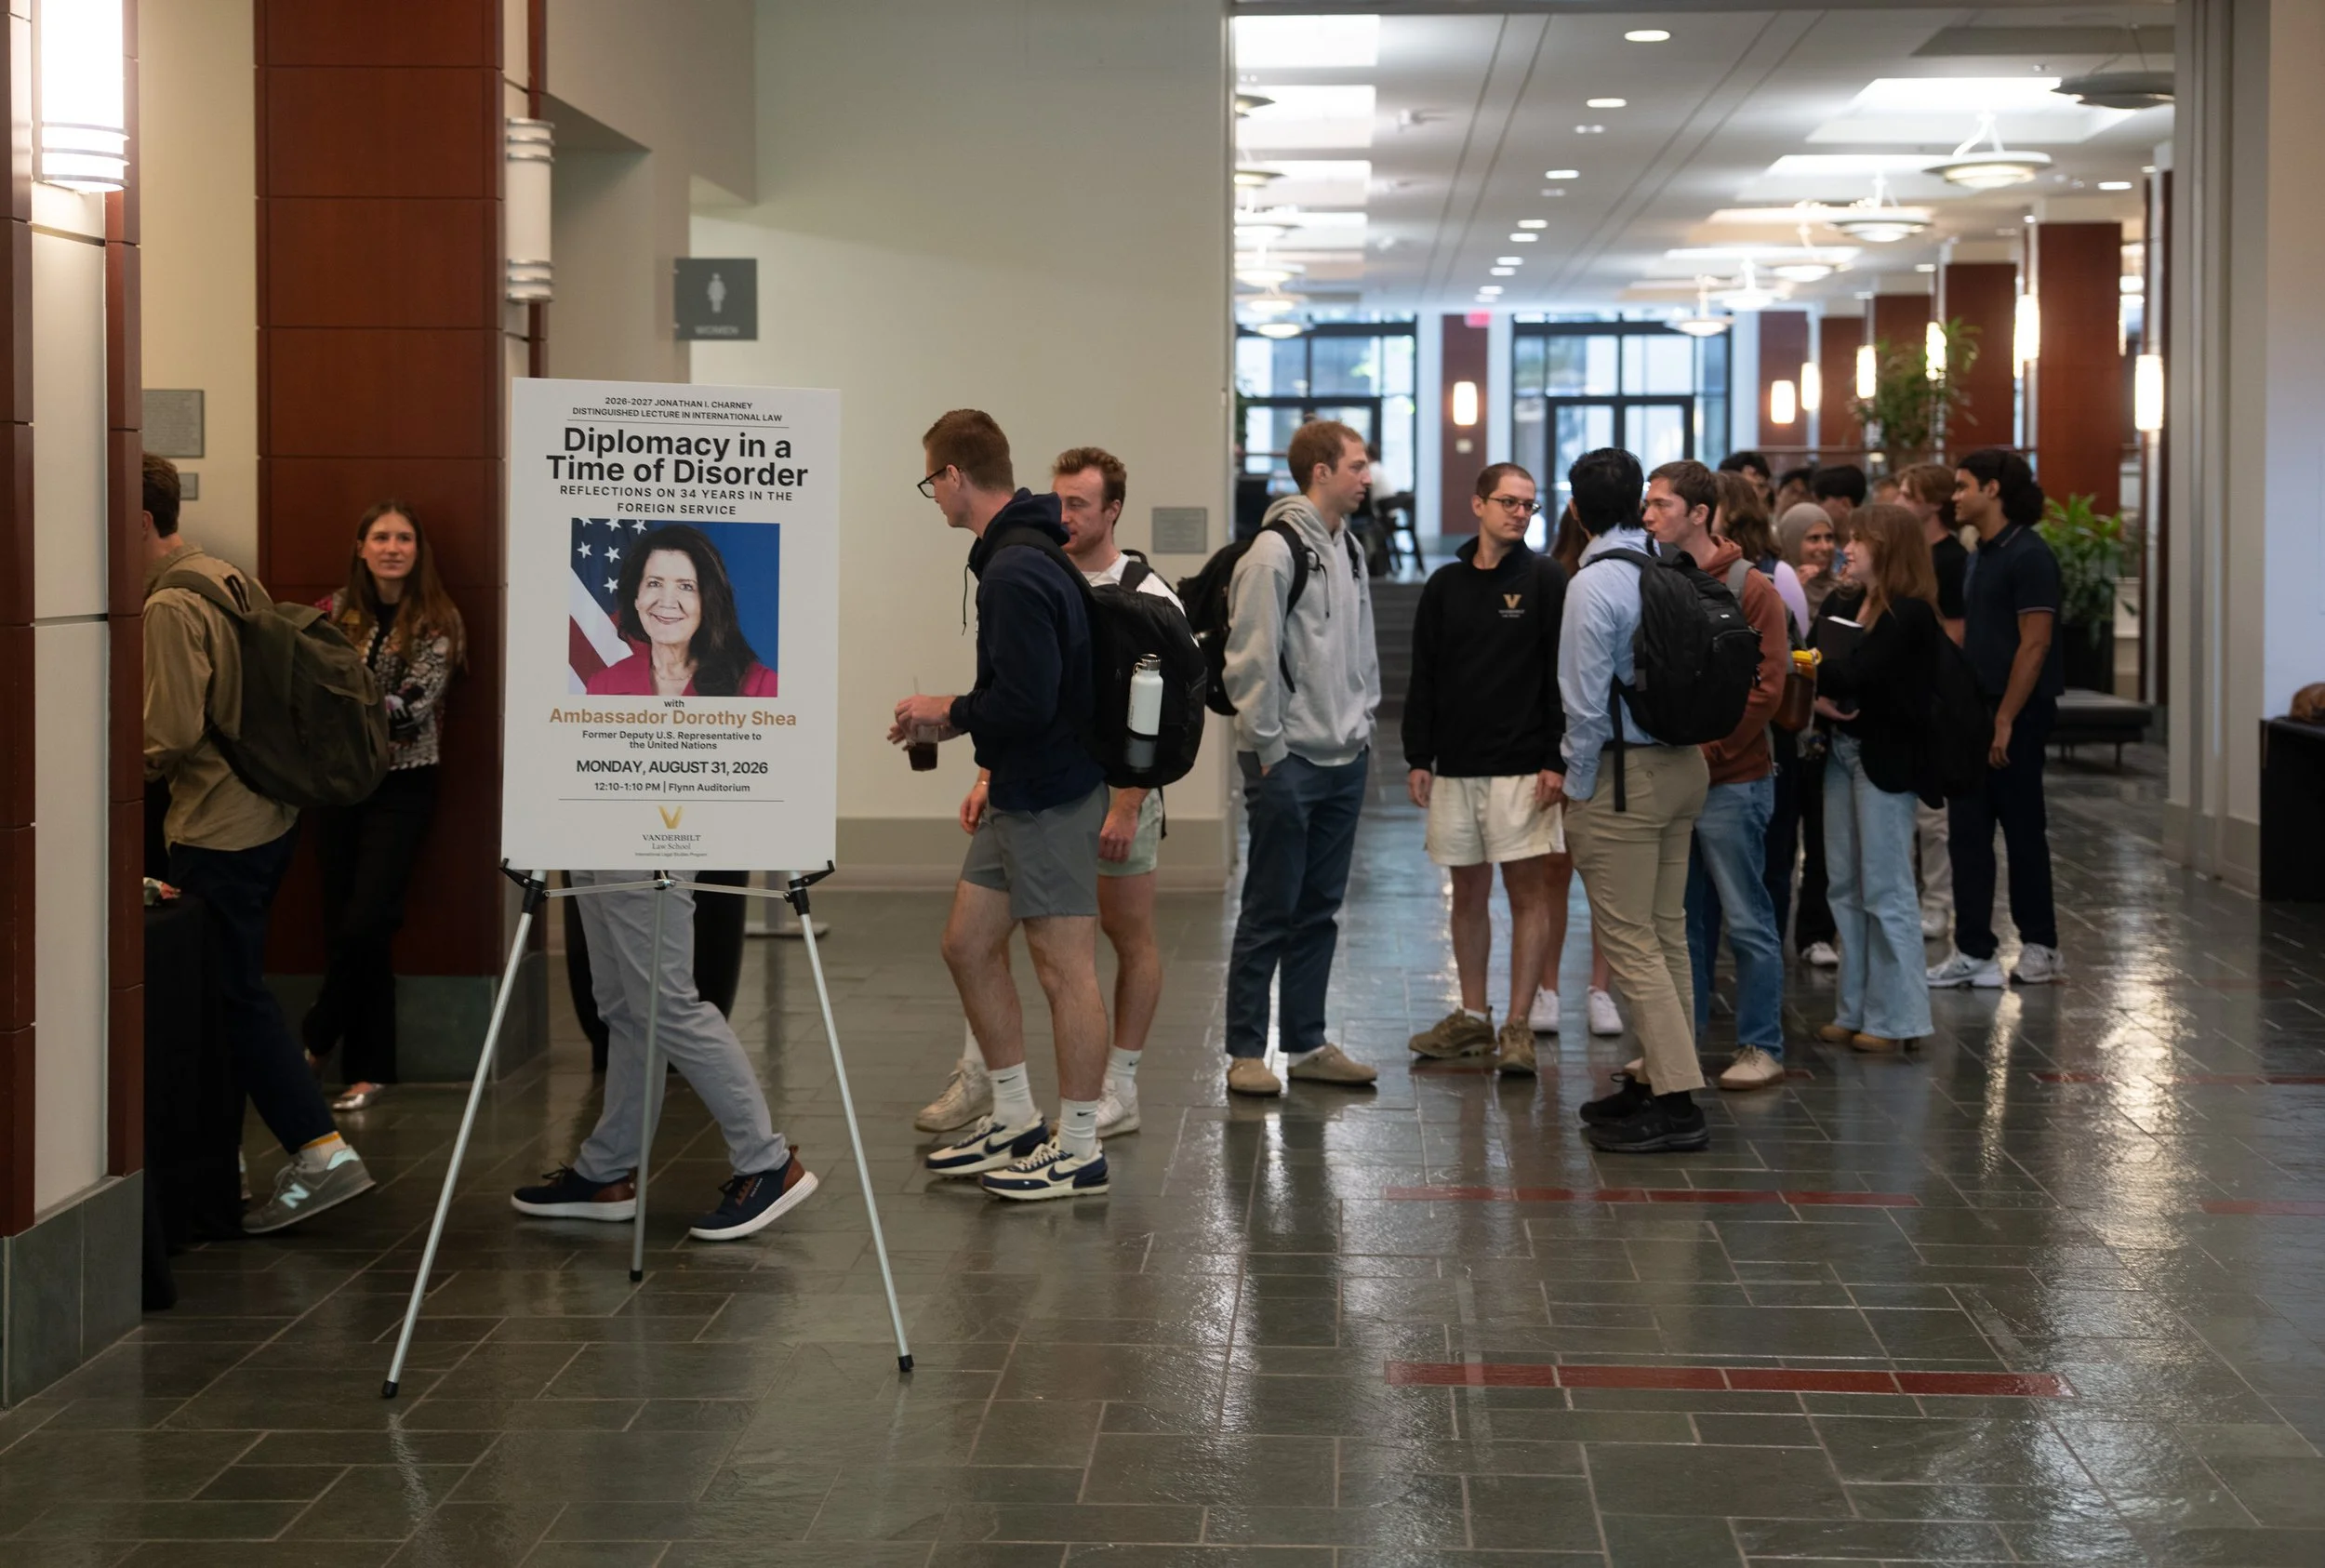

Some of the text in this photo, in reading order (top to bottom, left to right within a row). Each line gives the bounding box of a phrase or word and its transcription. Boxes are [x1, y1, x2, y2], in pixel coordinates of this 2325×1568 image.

[605, 397, 652, 406] 2026-2027
[654, 399, 703, 407] JONATHAN
[711, 401, 752, 409] CHARNEY
[572, 407, 639, 417] DISTINGUISHED
[641, 409, 680, 419] LECTURE
[692, 411, 761, 421] INTERNATIONAL
[762, 414, 782, 422] LAW
[565, 428, 791, 462] Diplomacy in a
[546, 454, 808, 486] Time of Disorder
[560, 485, 792, 501] REFLECTIONS ON 34 YEARS IN THE
[617, 502, 737, 515] FOREIGN SERVICE
[663, 698, 684, 708] with
[549, 708, 797, 729] Ambassador Dorothy Shea
[582, 730, 618, 739] Former
[619, 730, 655, 742] Deputy
[656, 731, 675, 739] U.S.
[677, 731, 751, 741] Representative
[630, 740, 718, 750] the United Nations
[577, 760, 768, 776] MONDAY, AUGUST 31, 2026
[594, 782, 644, 791] 12:10-1:10
[644, 782, 660, 791] PM
[668, 782, 695, 793] Flynn
[697, 783, 751, 792] Auditorium
